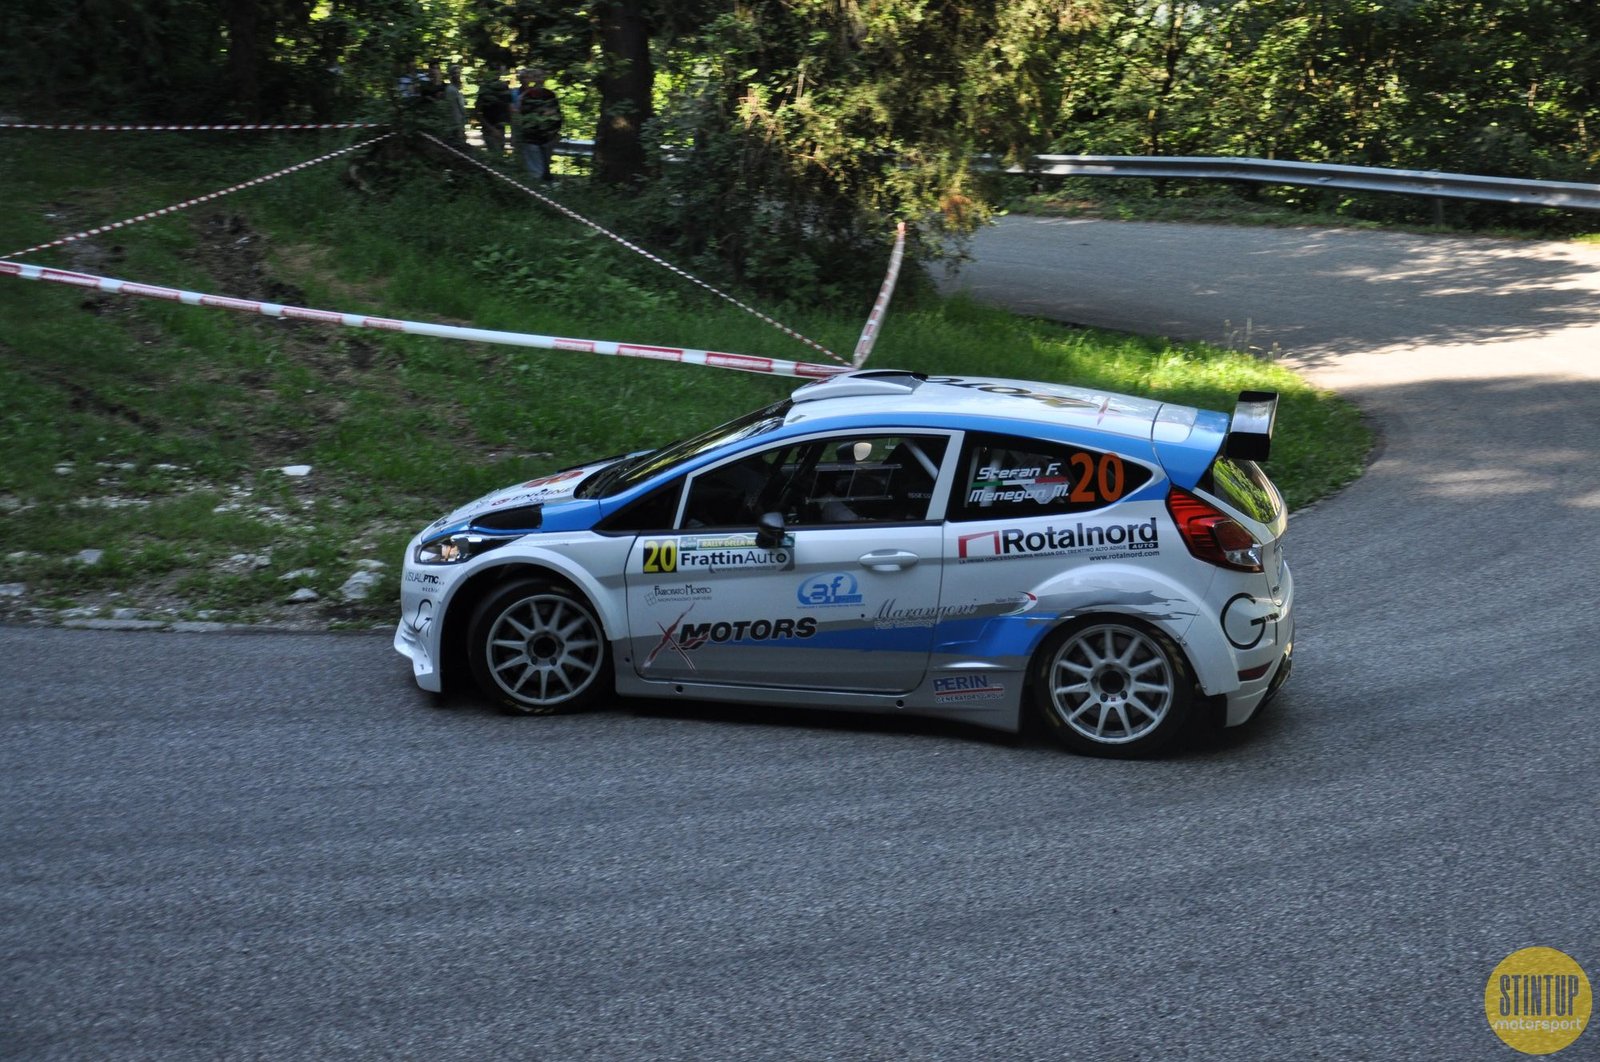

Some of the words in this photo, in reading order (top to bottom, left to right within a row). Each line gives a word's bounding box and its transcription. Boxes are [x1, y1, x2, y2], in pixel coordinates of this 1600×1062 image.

[977, 466, 1040, 480] Stefan
[1045, 462, 1061, 476] F.
[1070, 452, 1124, 503] 20
[969, 488, 1047, 503] Menegon
[1002, 517, 1158, 553] Rotalnord
[643, 540, 677, 573] 20
[1089, 550, 1160, 561] www.rotalnord.com
[876, 598, 978, 624] Marangoni
[932, 675, 988, 691] PERIN
